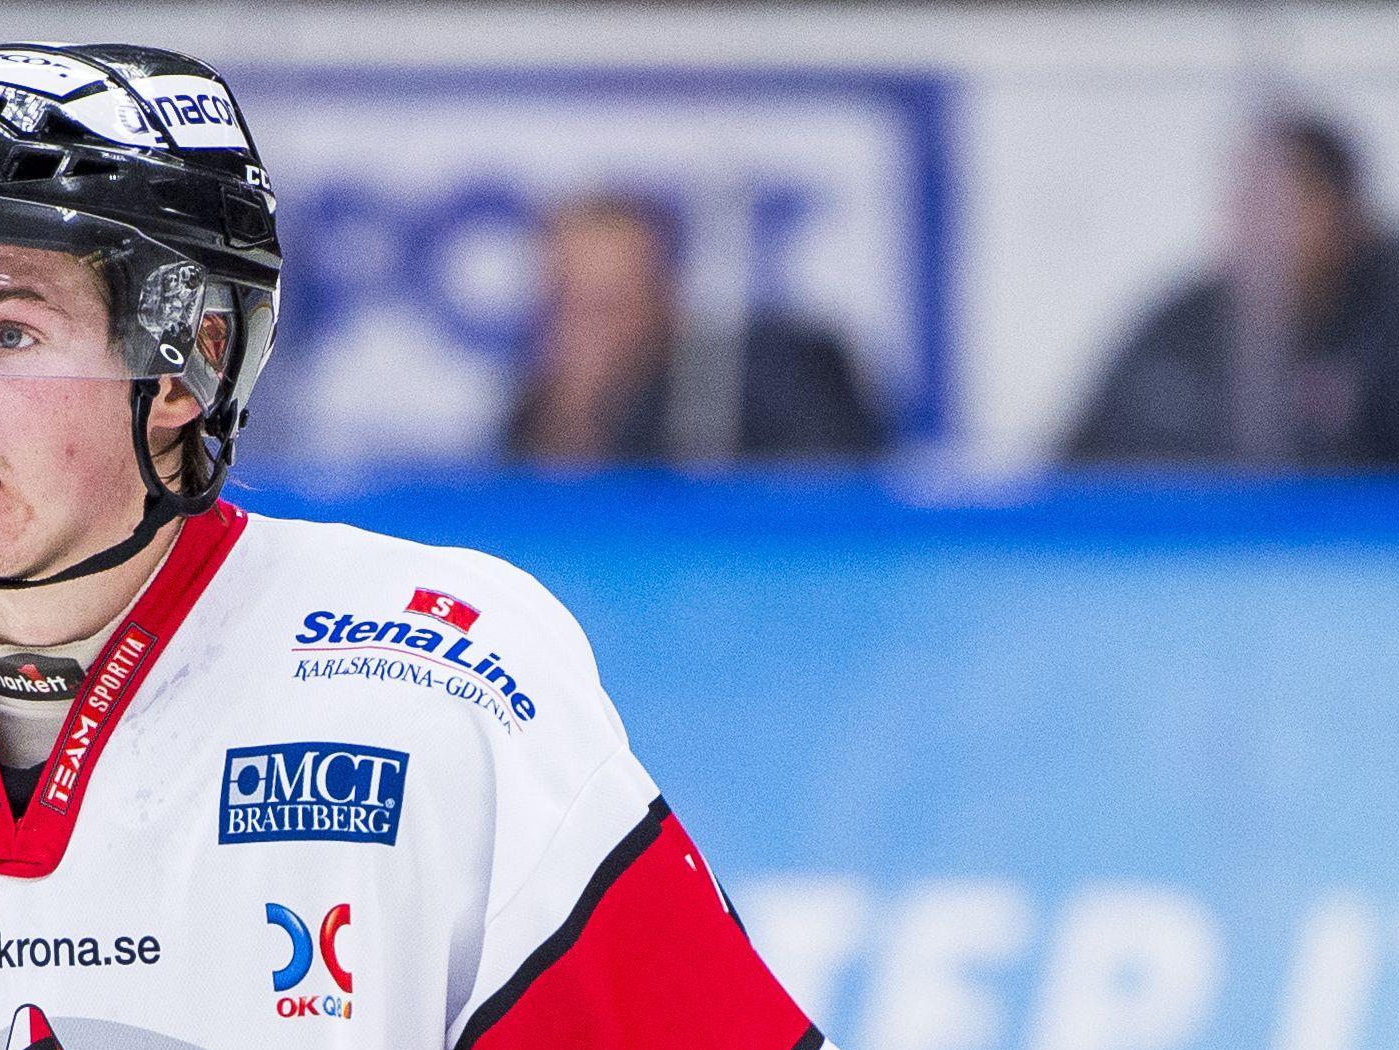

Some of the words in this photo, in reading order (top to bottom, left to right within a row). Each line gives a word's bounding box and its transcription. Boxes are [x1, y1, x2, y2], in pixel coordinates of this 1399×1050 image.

[245, 165, 271, 189] CC
[295, 611, 444, 653] Stena
[442, 637, 536, 722] Line
[48, 714, 98, 803] TEAM
[88, 637, 146, 713] SPORTIA
[227, 805, 391, 834] BRATTBERG
